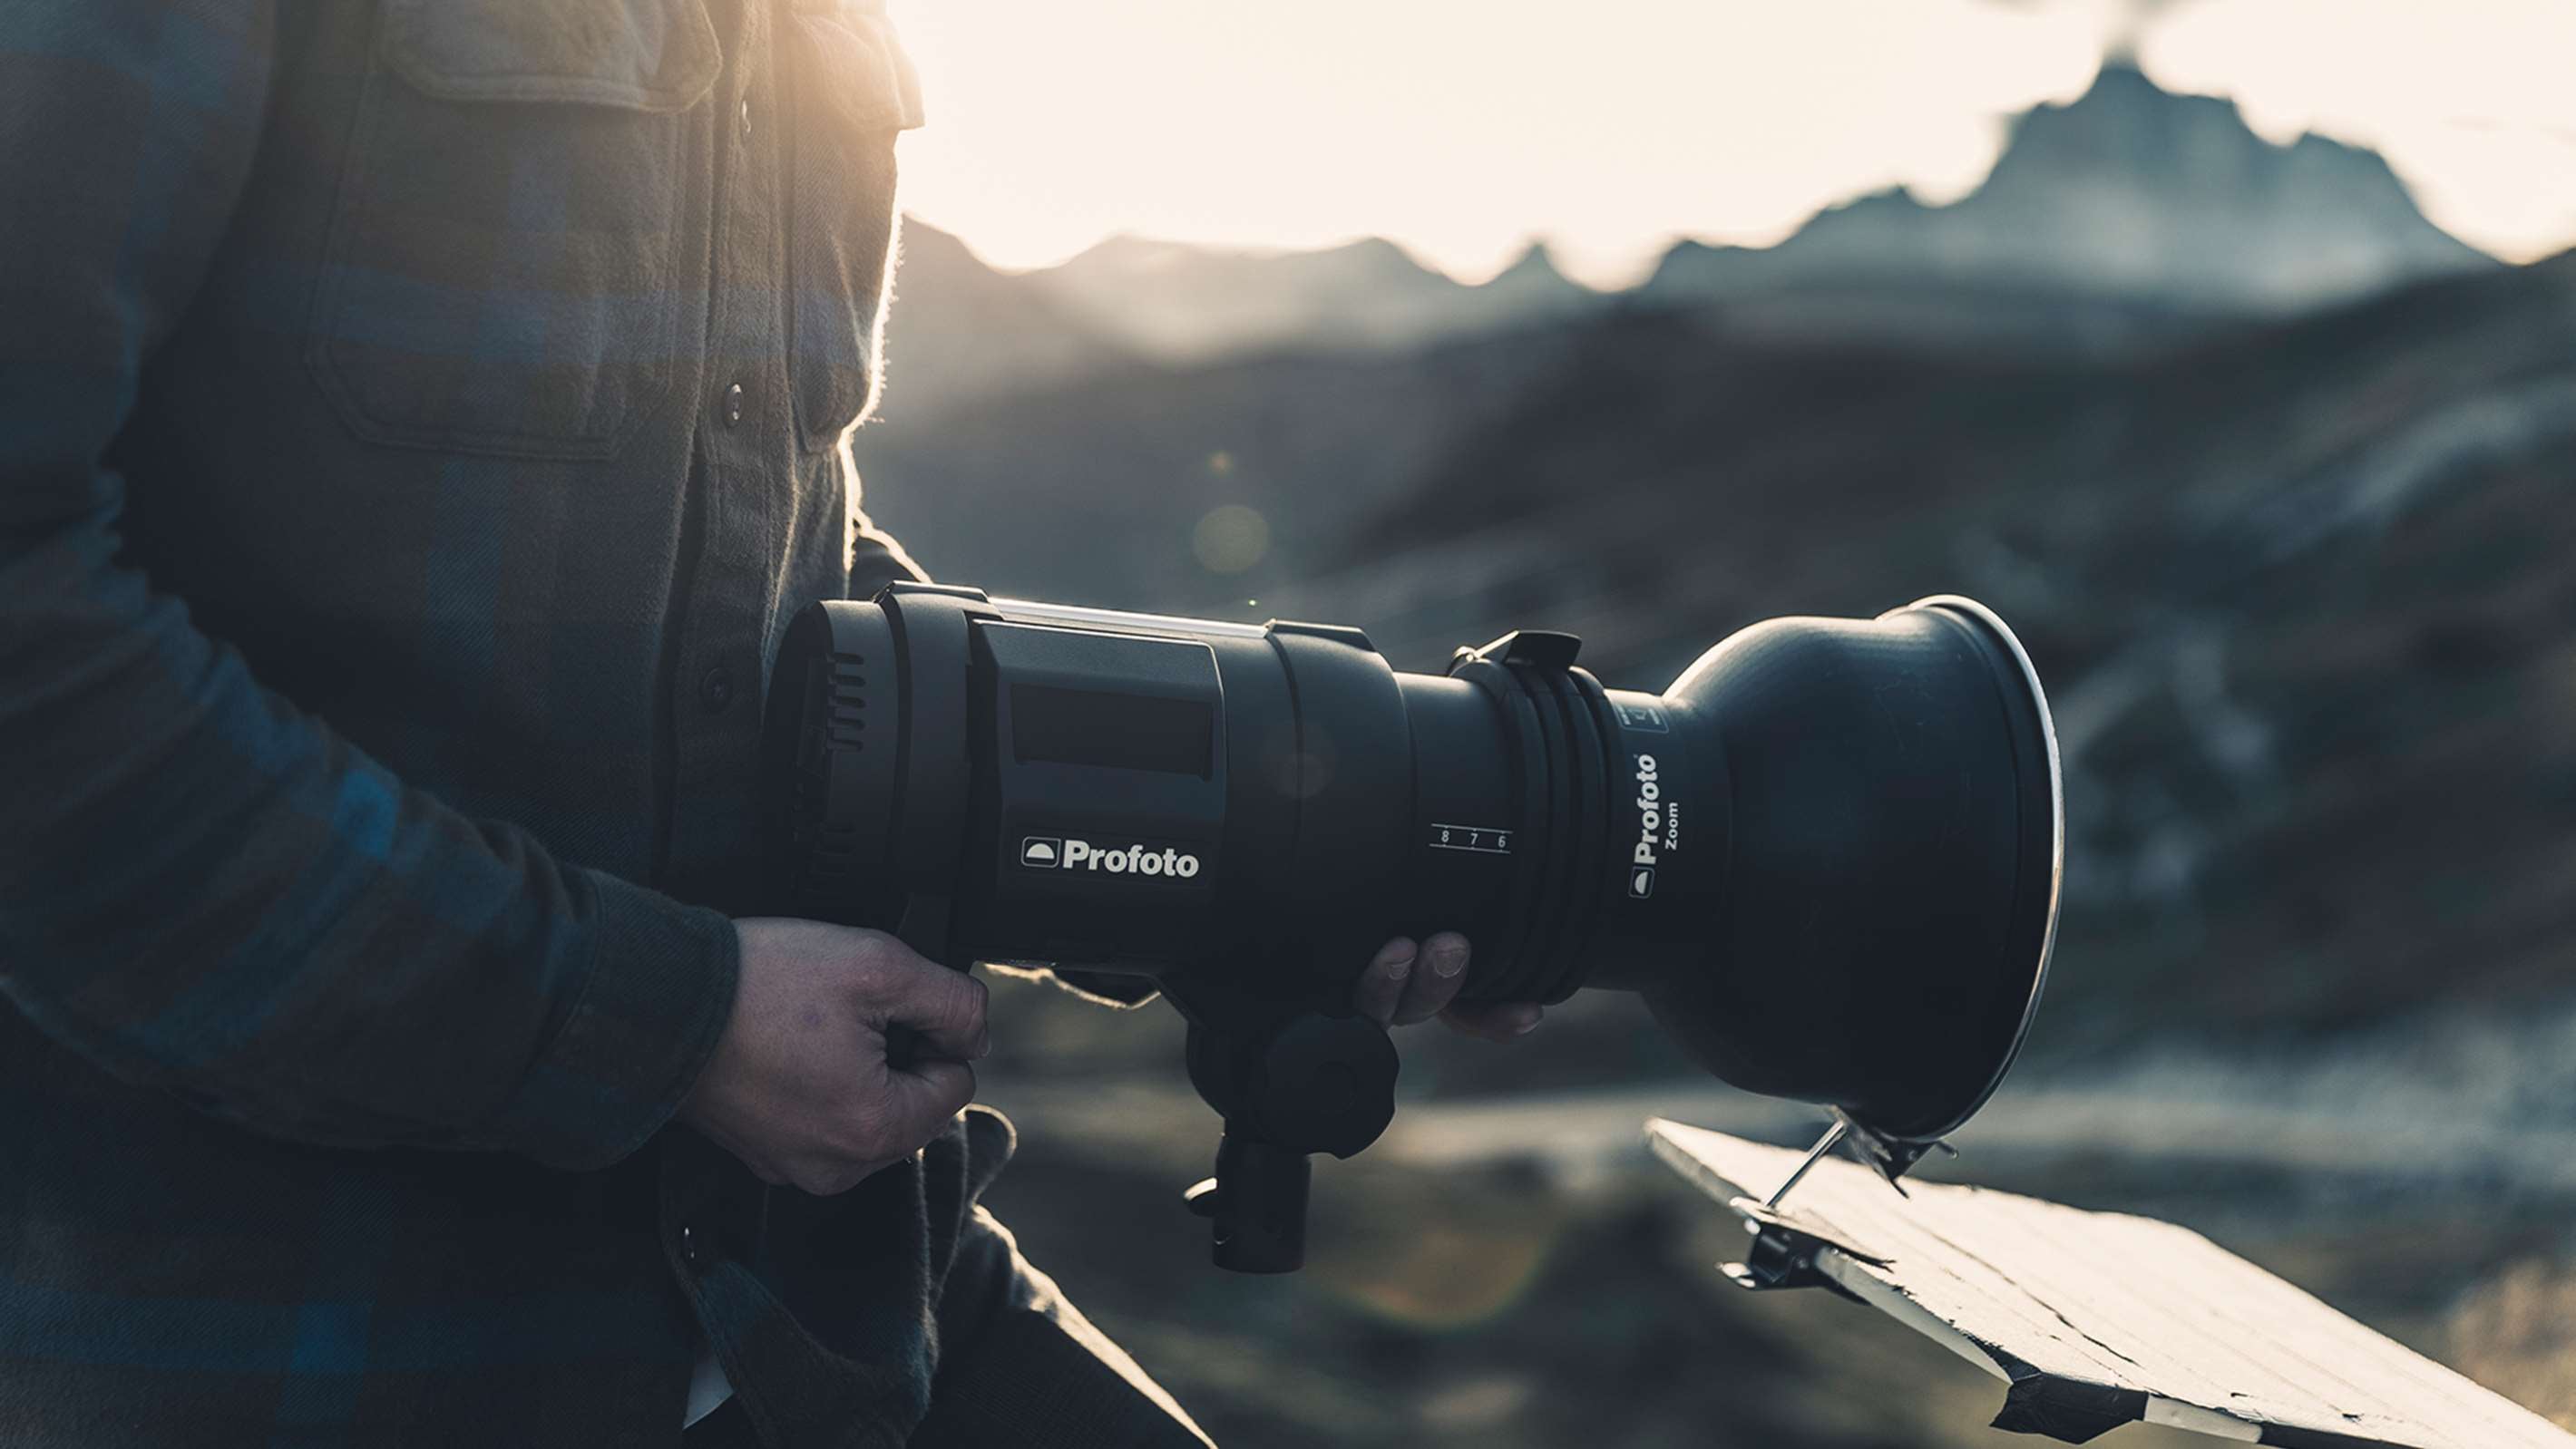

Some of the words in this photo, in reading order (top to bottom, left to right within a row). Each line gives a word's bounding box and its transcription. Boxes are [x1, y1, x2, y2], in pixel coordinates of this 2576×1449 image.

[1634, 754, 1660, 865] Profoto
[1664, 802, 1679, 851] Zoom
[1062, 839, 1200, 879] Profoto
[1440, 830, 1450, 843] 8
[1470, 832, 1478, 845] 7
[1498, 835, 1507, 848] 6
